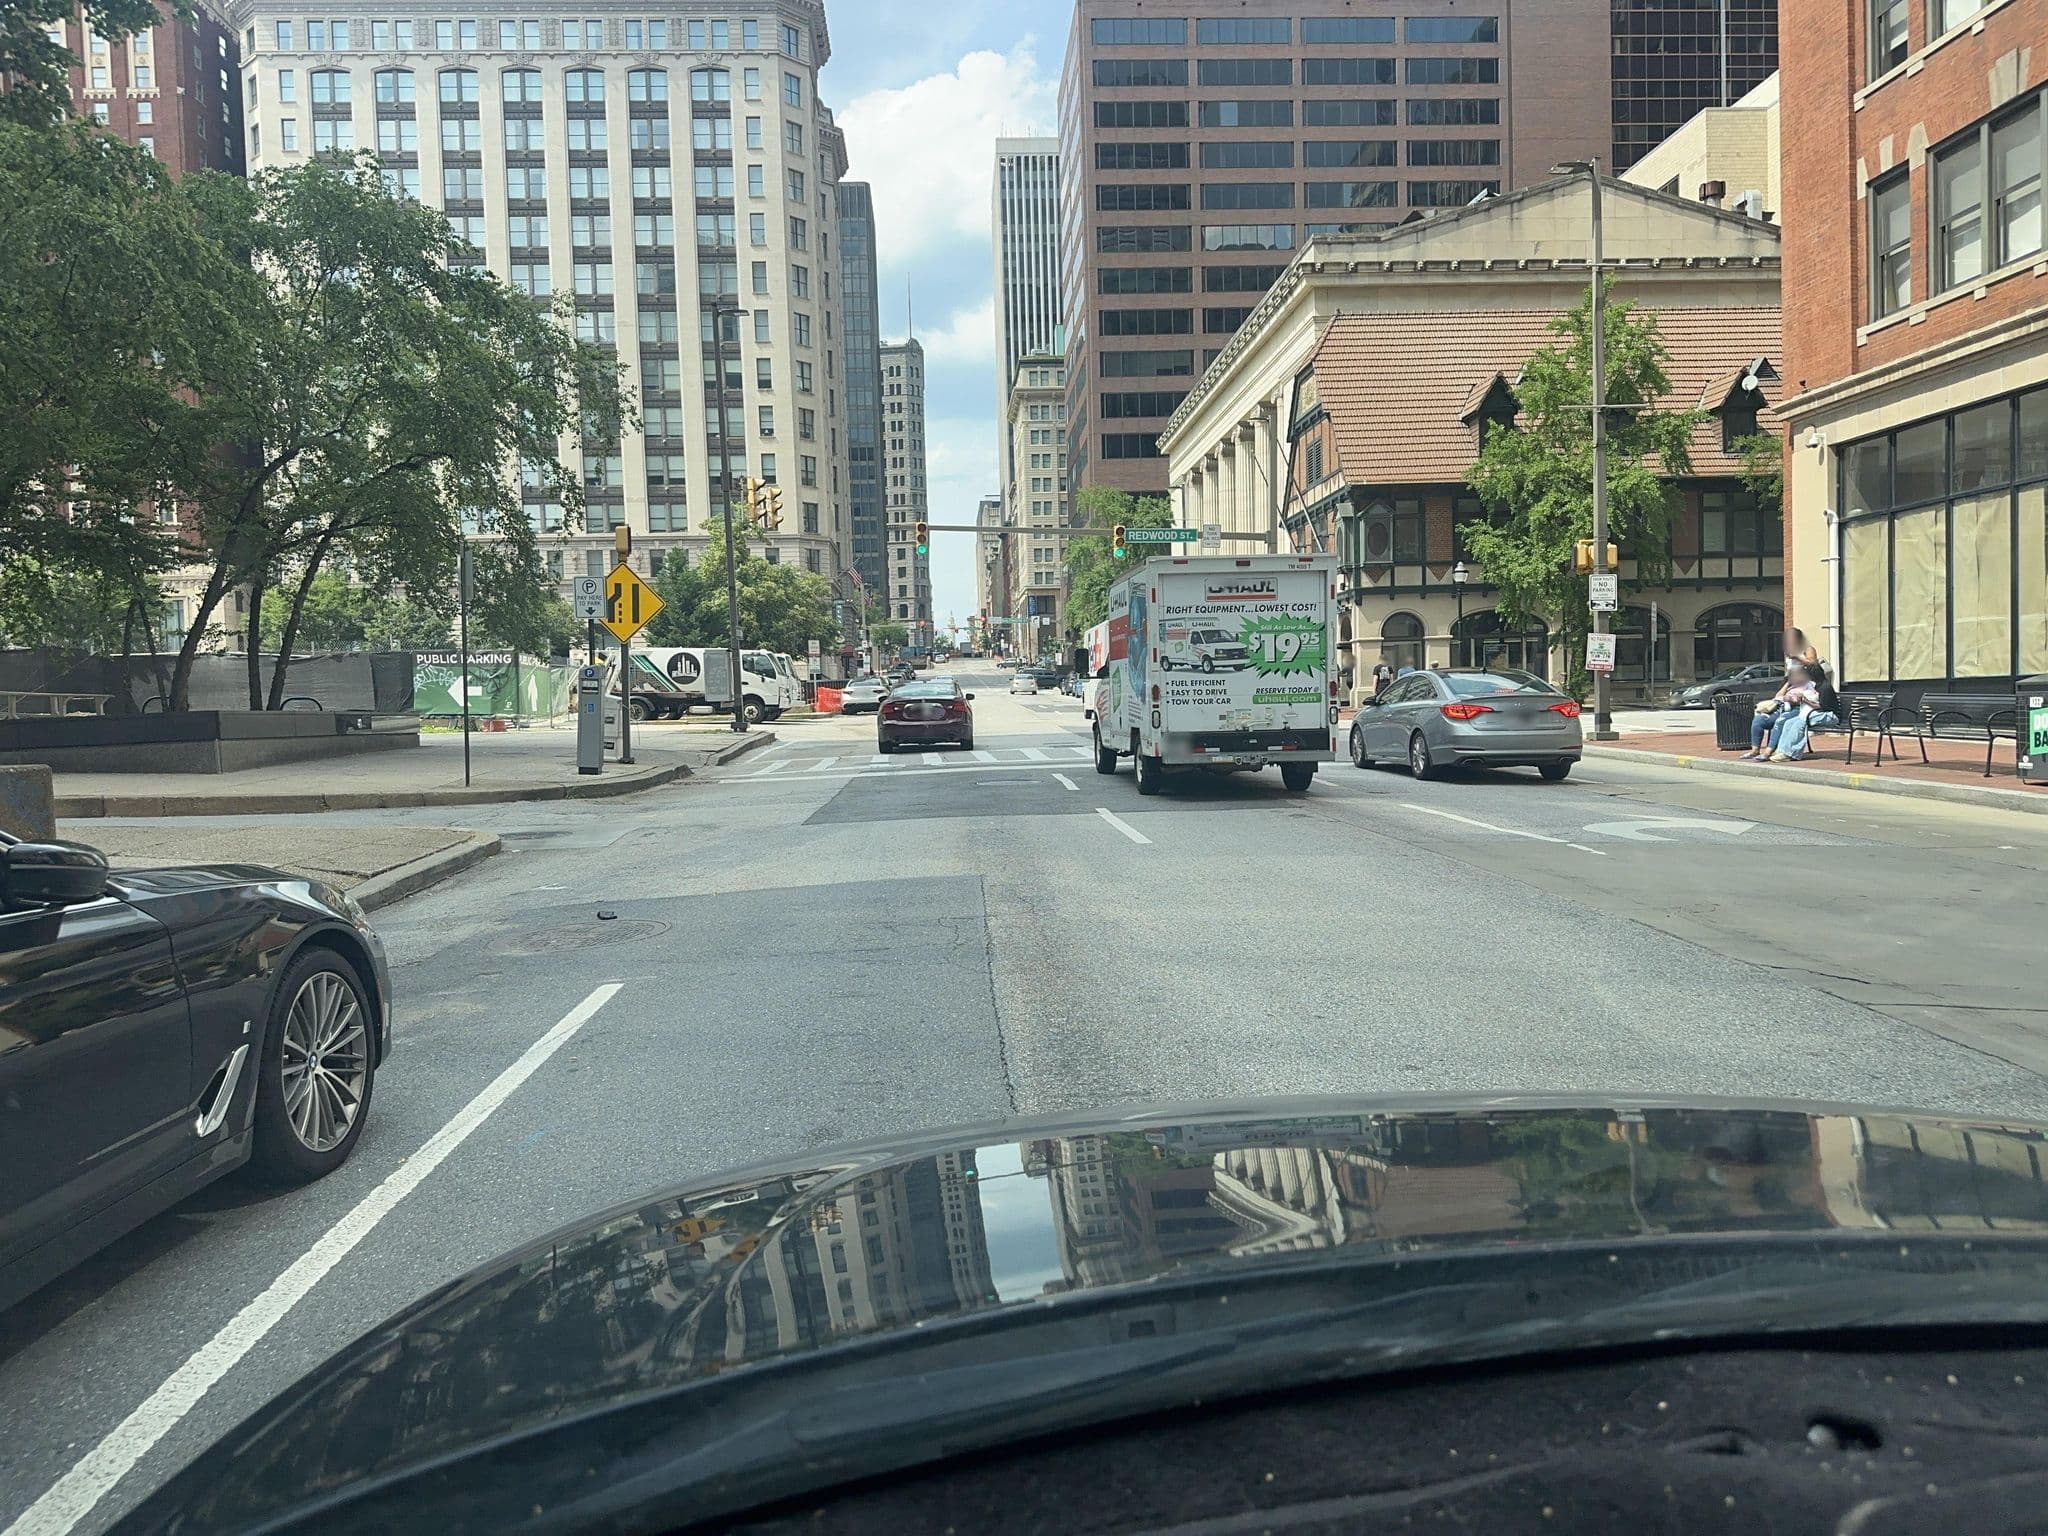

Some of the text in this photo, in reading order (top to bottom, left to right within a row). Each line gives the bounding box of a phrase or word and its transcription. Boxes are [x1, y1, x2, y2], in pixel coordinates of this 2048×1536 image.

[1128, 530, 1177, 541] REDWOOD
[1166, 606, 1193, 614] RIGHT
[1291, 603, 1317, 611] COST!
[416, 654, 458, 664] PUBLIC
[1258, 695, 1317, 703] uhaul.com
